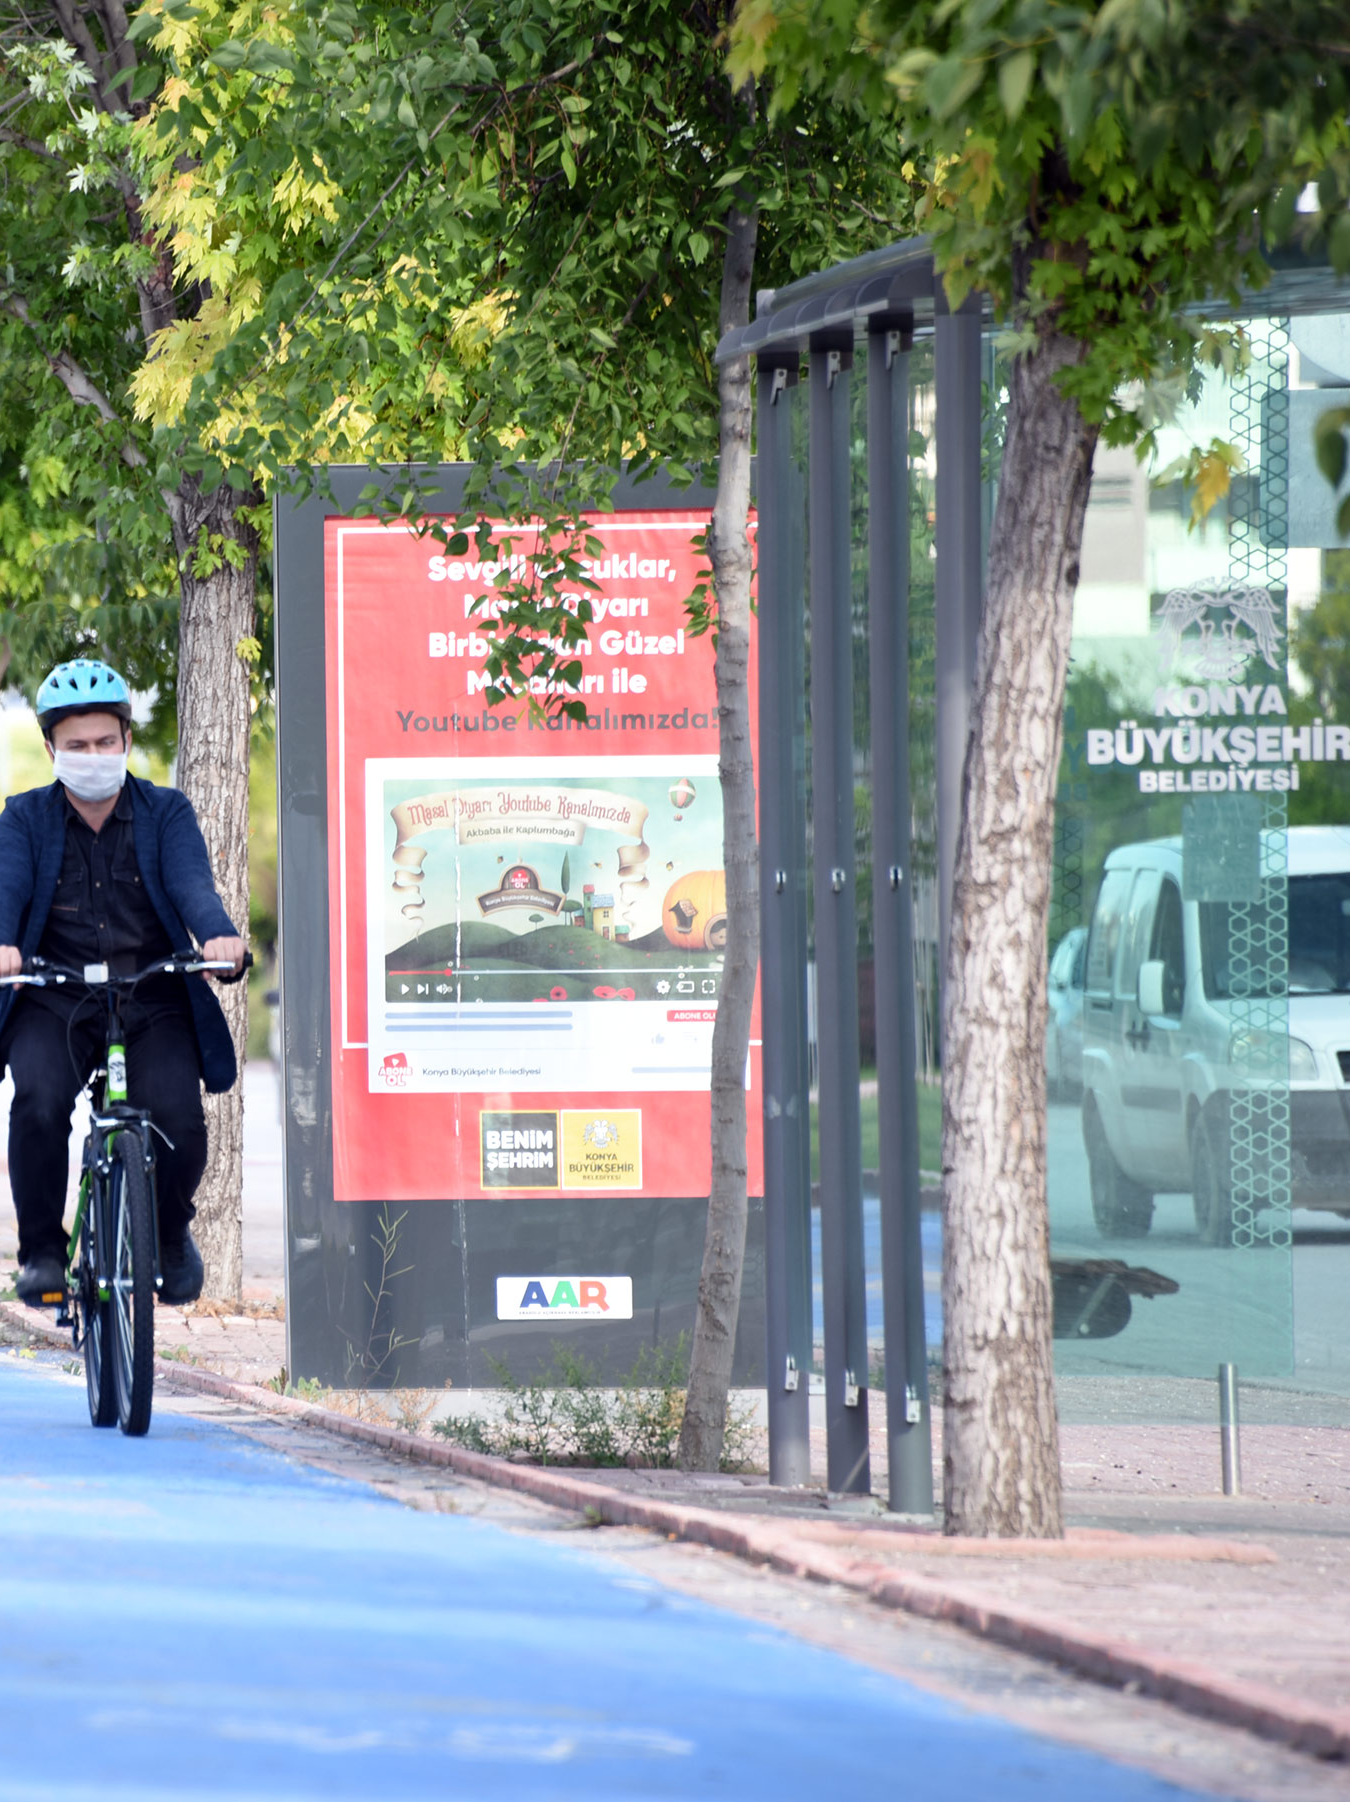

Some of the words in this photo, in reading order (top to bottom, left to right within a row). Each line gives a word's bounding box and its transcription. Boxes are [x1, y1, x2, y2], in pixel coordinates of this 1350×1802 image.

[600, 629, 685, 656] Güzel
[612, 667, 648, 694] ile
[1155, 685, 1287, 717] KONYA
[396, 710, 517, 732] Youtube
[1087, 717, 1350, 768] BÜYÜKŞEHİR
[1139, 763, 1299, 793] BELEDİYESİ
[407, 799, 449, 826] Masal
[497, 791, 552, 815] Youtube
[557, 795, 631, 824] Kanalımızda
[466, 826, 502, 838] Akbaba
[503, 825, 515, 834] ile
[516, 825, 576, 838] Kaplumbağa
[674, 1012, 701, 1020] ABONE
[378, 1066, 413, 1077] ABONE
[385, 1075, 406, 1088] OL
[422, 1067, 449, 1078] Konya
[451, 1067, 496, 1077] Büyükşehir
[499, 1067, 541, 1077] Belediyesi
[569, 1162, 634, 1173] BÜYÜKŞEHİR
[585, 1153, 618, 1161] KONYA
[519, 1280, 610, 1312] AAR
